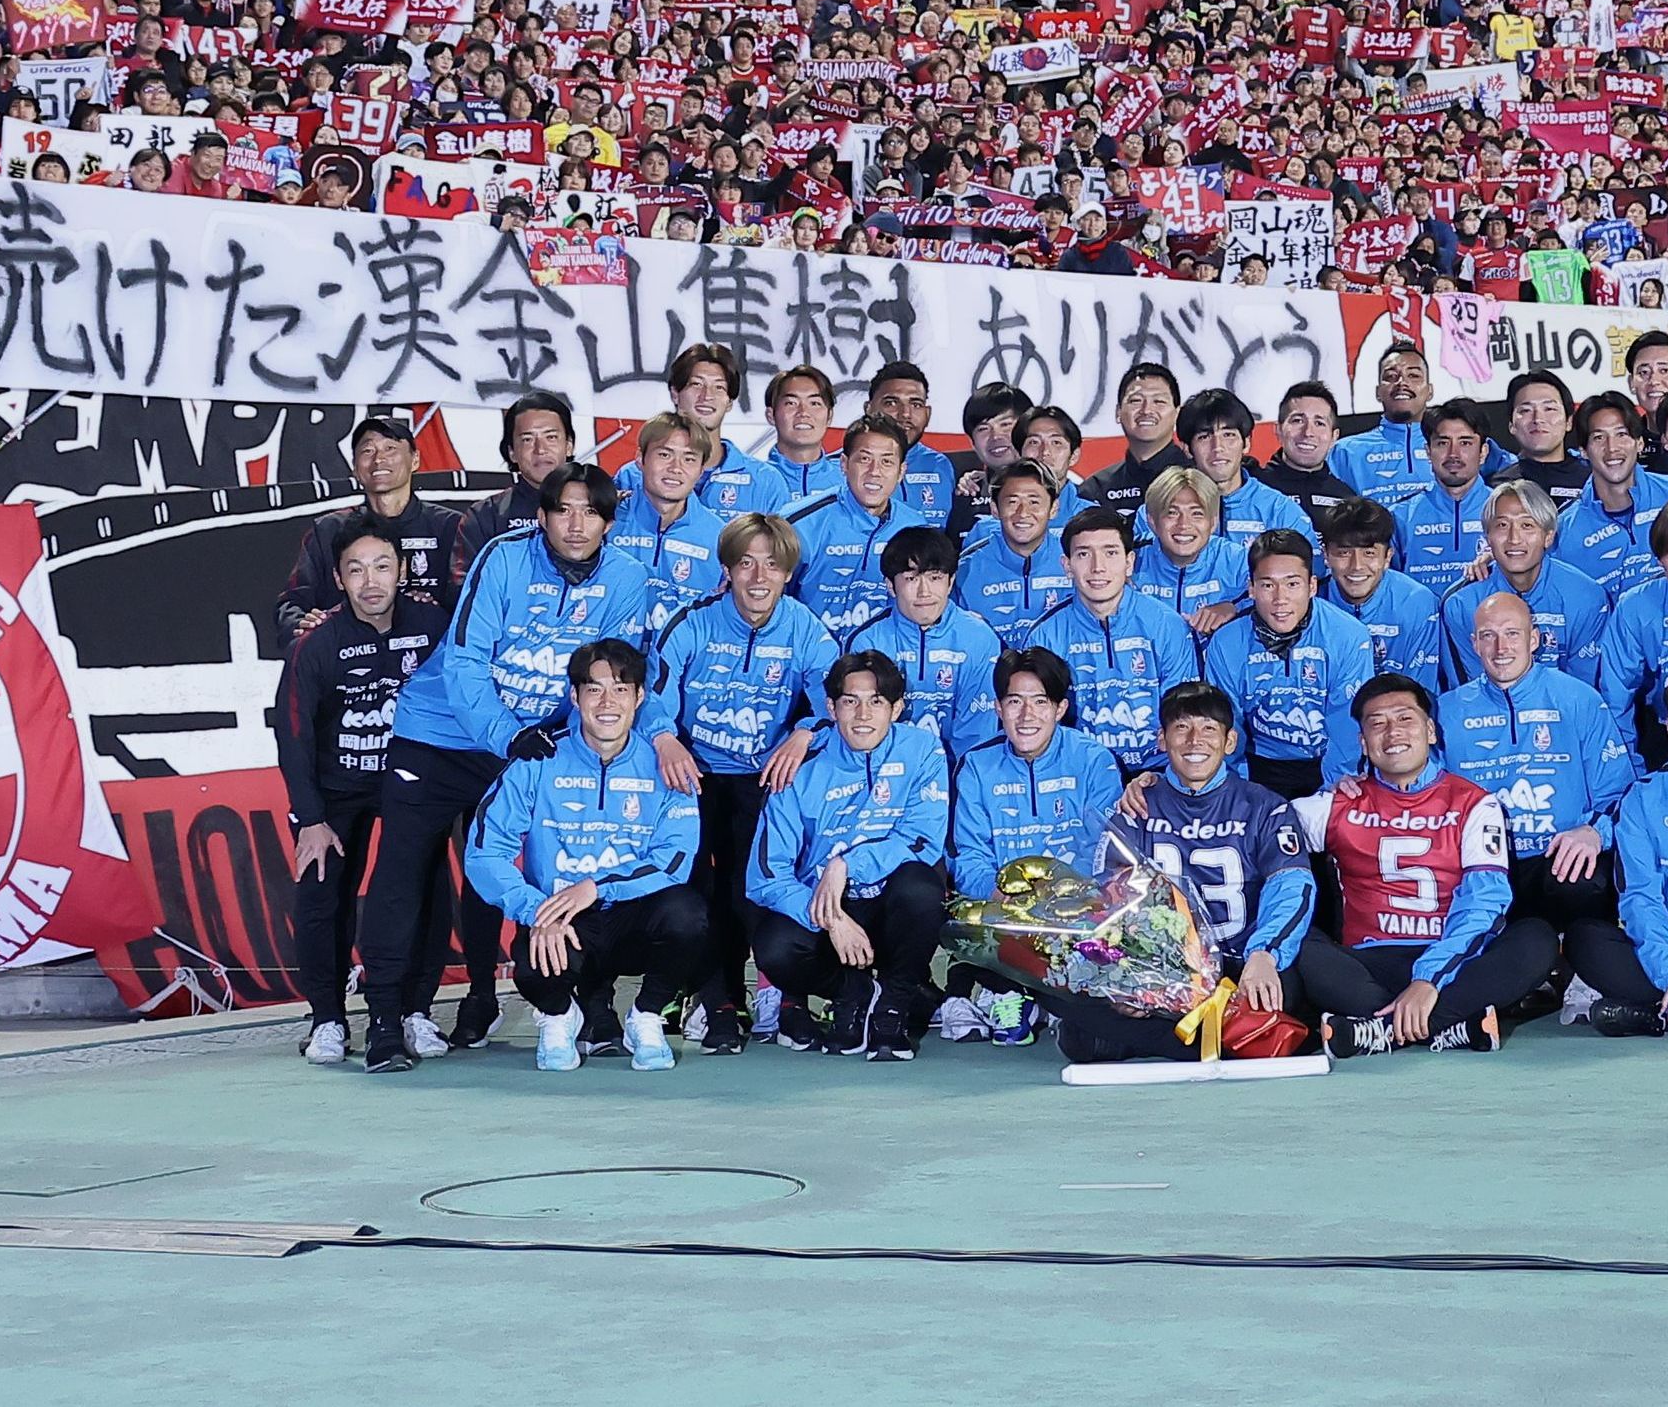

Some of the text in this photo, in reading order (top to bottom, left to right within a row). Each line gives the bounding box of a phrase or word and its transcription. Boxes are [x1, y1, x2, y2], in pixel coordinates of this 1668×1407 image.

[436, 10, 447, 20] 27
[1440, 36, 1457, 61] 5
[30, 64, 92, 76] un.deux
[806, 60, 857, 82] FAGIANO
[36, 78, 86, 121] 50
[1506, 101, 1556, 114] SVEND
[338, 100, 390, 143] 39
[1518, 110, 1607, 126] BRODERSEN
[1582, 123, 1609, 136] #49
[23, 131, 53, 154] 19
[1161, 186, 1199, 220] 43
[1541, 270, 1570, 304] 13
[1146, 815, 1247, 841] un.deux
[1347, 808, 1459, 831] un.deux
[1377, 836, 1440, 913] 5
